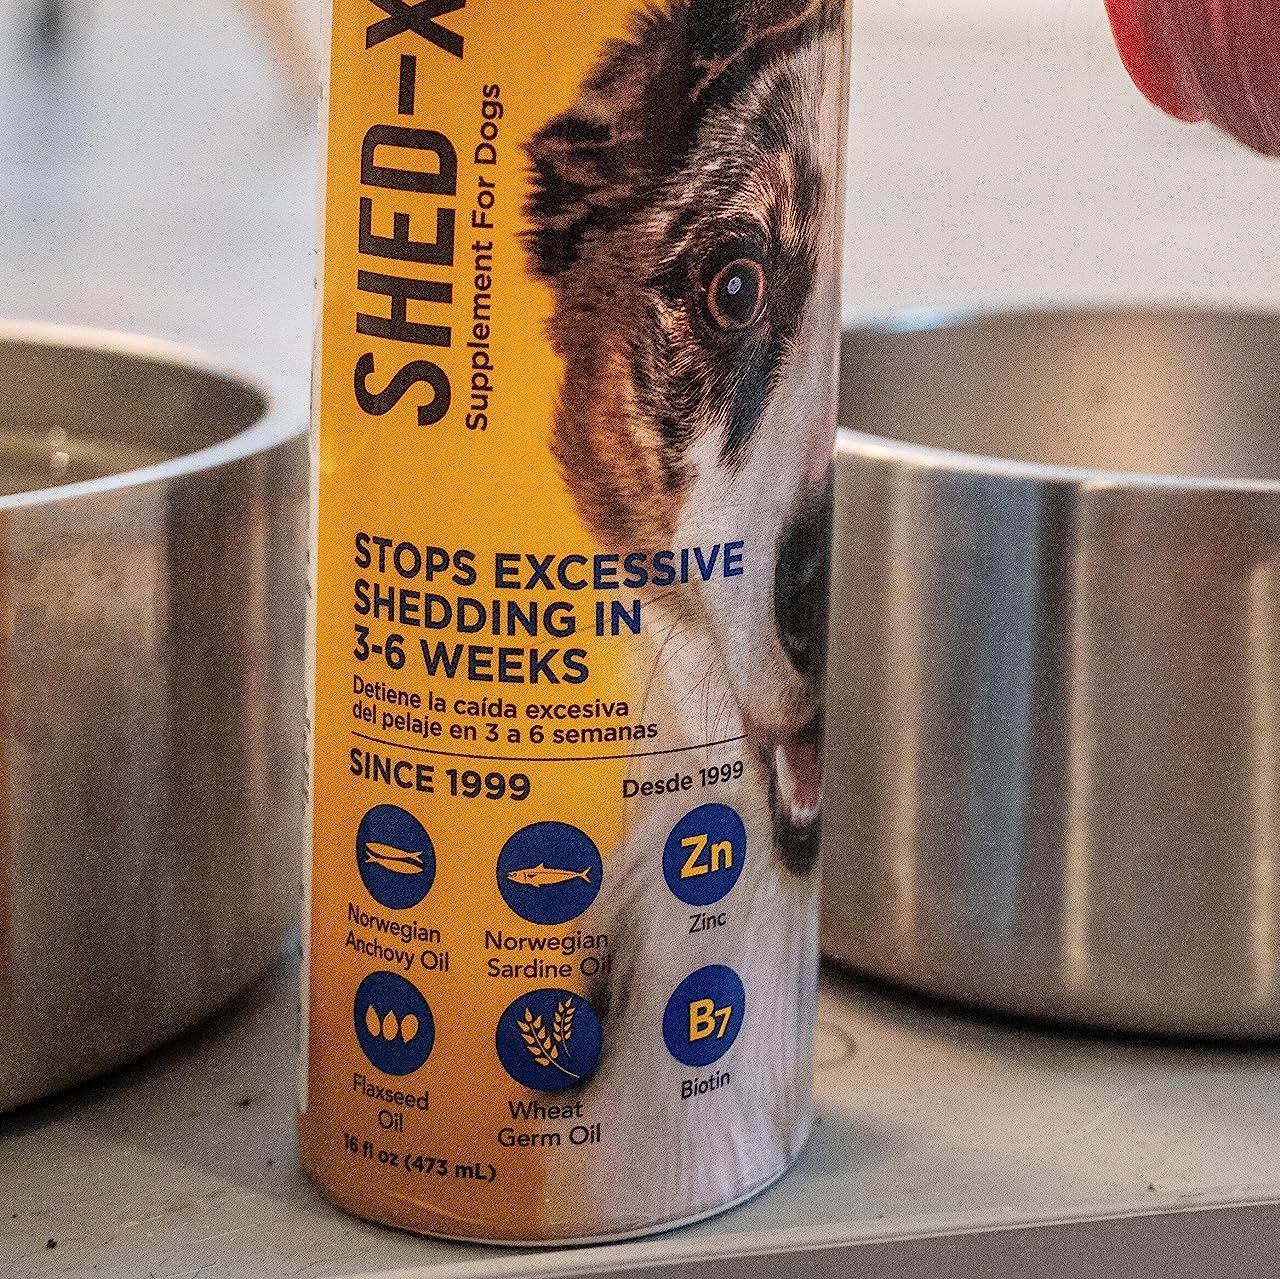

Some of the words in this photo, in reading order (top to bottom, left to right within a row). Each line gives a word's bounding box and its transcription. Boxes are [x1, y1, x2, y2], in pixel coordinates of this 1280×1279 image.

[474, 83, 504, 165] Dogs
[473, 176, 496, 230] For
[466, 238, 495, 432] Supplement
[354, 531, 477, 587] STOPS
[494, 540, 745, 590] EXCESSIVE
[354, 578, 575, 637] SHEDDING
[595, 600, 641, 636] IN
[353, 624, 405, 670] 3-6
[420, 638, 589, 684] WEEKS
[353, 675, 421, 709] Detiene
[428, 691, 447, 713] la
[454, 697, 517, 719] caída
[525, 698, 629, 720] excesiva
[352, 702, 377, 724] del
[382, 714, 443, 738] pelaje
[449, 725, 477, 741] en
[485, 723, 499, 742] 3
[507, 729, 521, 744] a
[528, 723, 544, 744] 6
[553, 721, 658, 745] semanas
[349, 747, 435, 793] SINCE
[445, 768, 531, 801] 1999
[622, 774, 694, 799] Desde
[700, 761, 744, 787] 1999
[680, 835, 733, 878] Zn
[348, 903, 441, 946] Norwegian
[485, 931, 608, 955] Norwegian
[689, 911, 726, 934] Zinc
[345, 931, 414, 972] Anchovy
[420, 950, 449, 972] Oil
[487, 960, 573, 979] Sardine
[580, 956, 613, 977] Oil
[353, 1073, 429, 1111] Flaxseed
[681, 1070, 731, 1099] Biotin
[378, 1110, 403, 1132] Oil
[508, 1101, 583, 1120] Wheat
[498, 1127, 561, 1148] Germ
[569, 1124, 601, 1146] Oil
[344, 1133, 358, 1153] 16
[362, 1142, 373, 1160] fl
[379, 1151, 398, 1166] oz
[404, 1155, 448, 1177] (473
[455, 1163, 497, 1183] mL)
